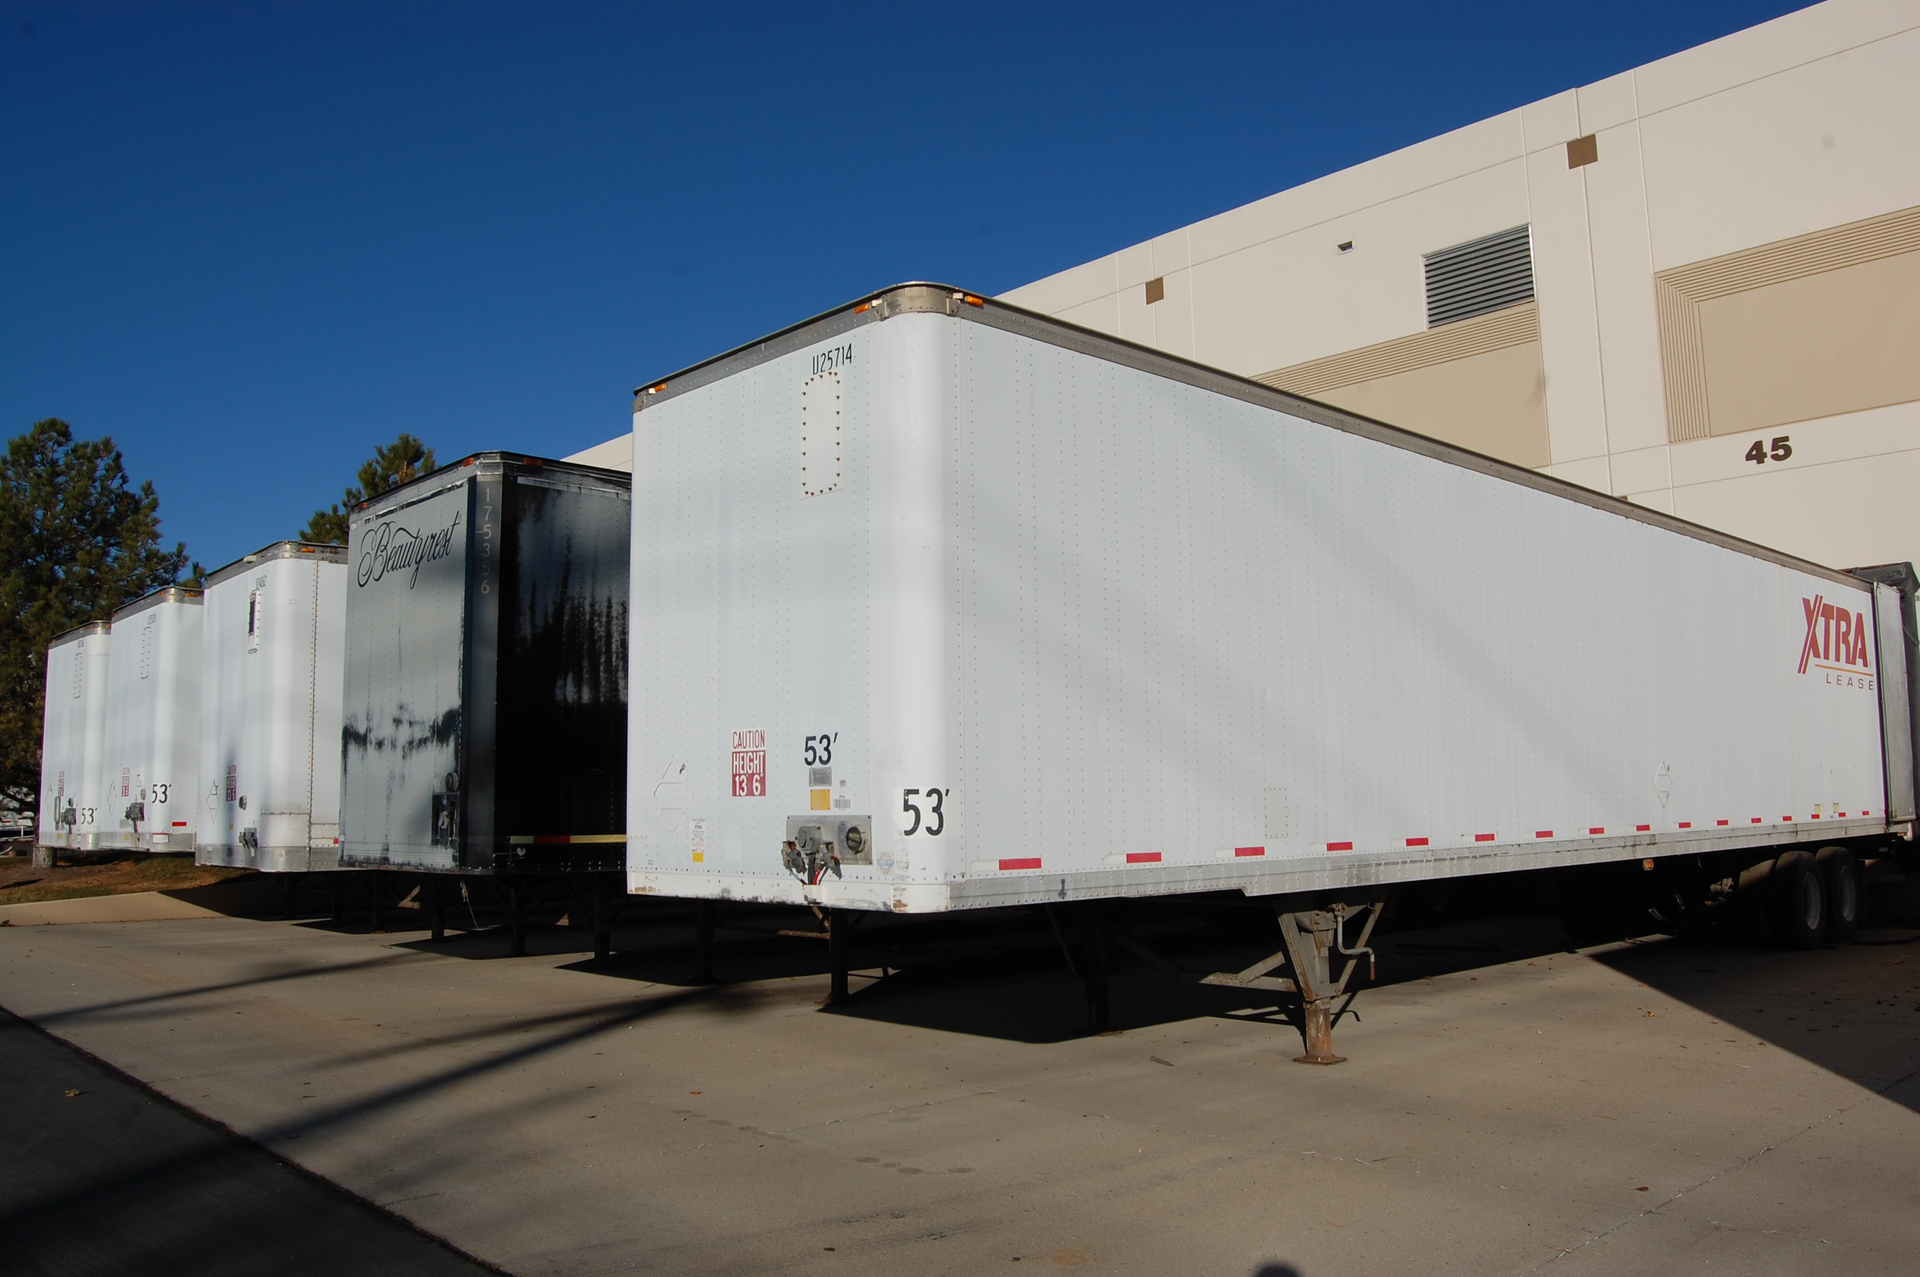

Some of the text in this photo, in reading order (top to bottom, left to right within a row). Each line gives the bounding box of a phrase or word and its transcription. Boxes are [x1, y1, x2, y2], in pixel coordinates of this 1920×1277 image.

[812, 343, 852, 375] U25714
[1745, 435, 1793, 465] 45
[358, 510, 461, 590] Beautyrest
[1797, 594, 1869, 674] XTRA
[1826, 673, 1874, 690] LEASE
[732, 729, 765, 749] CAUTION
[803, 732, 838, 766] 53'
[733, 751, 765, 774] HEIGHT
[903, 788, 950, 836] 53'
